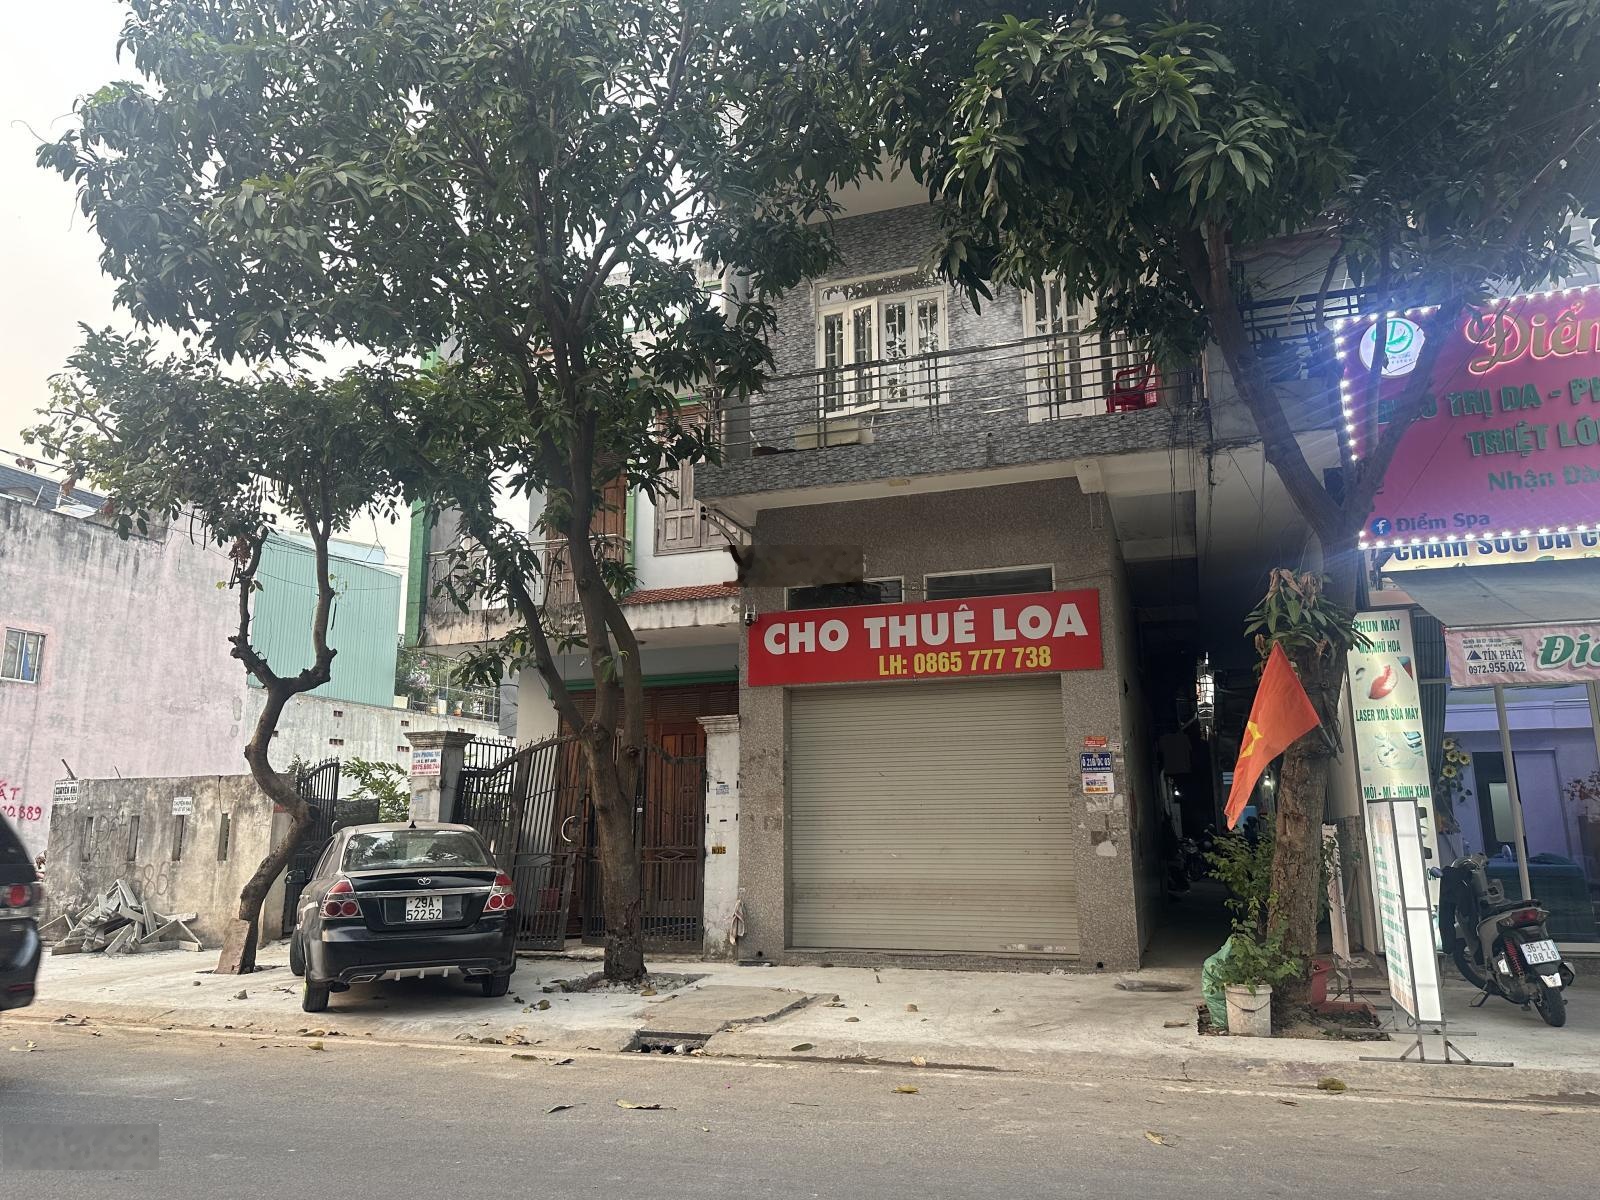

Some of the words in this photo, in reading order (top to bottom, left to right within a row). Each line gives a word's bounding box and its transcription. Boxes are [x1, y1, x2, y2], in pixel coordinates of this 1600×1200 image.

[1446, 388, 1493, 418] TRỊ
[1499, 383, 1541, 410] DA
[1466, 420, 1549, 457] TRIỆT
[1558, 415, 1600, 447] LÔ
[1488, 468, 1555, 496] Nhận
[1395, 512, 1446, 533] Điểm
[1453, 512, 1490, 530] Spa
[763, 619, 850, 655] CHO
[863, 604, 976, 649] THUÊ
[992, 603, 1088, 641] LOA
[1387, 640, 1401, 652] HOA
[878, 654, 908, 676] LH:
[913, 651, 963, 674] 0865
[969, 649, 1005, 671] 777
[1011, 645, 1052, 669] 738
[1468, 661, 1526, 674] 0972.955.022
[1355, 708, 1375, 722] LASER
[415, 896, 434, 909] 29A
[406, 908, 442, 921] 522.52
